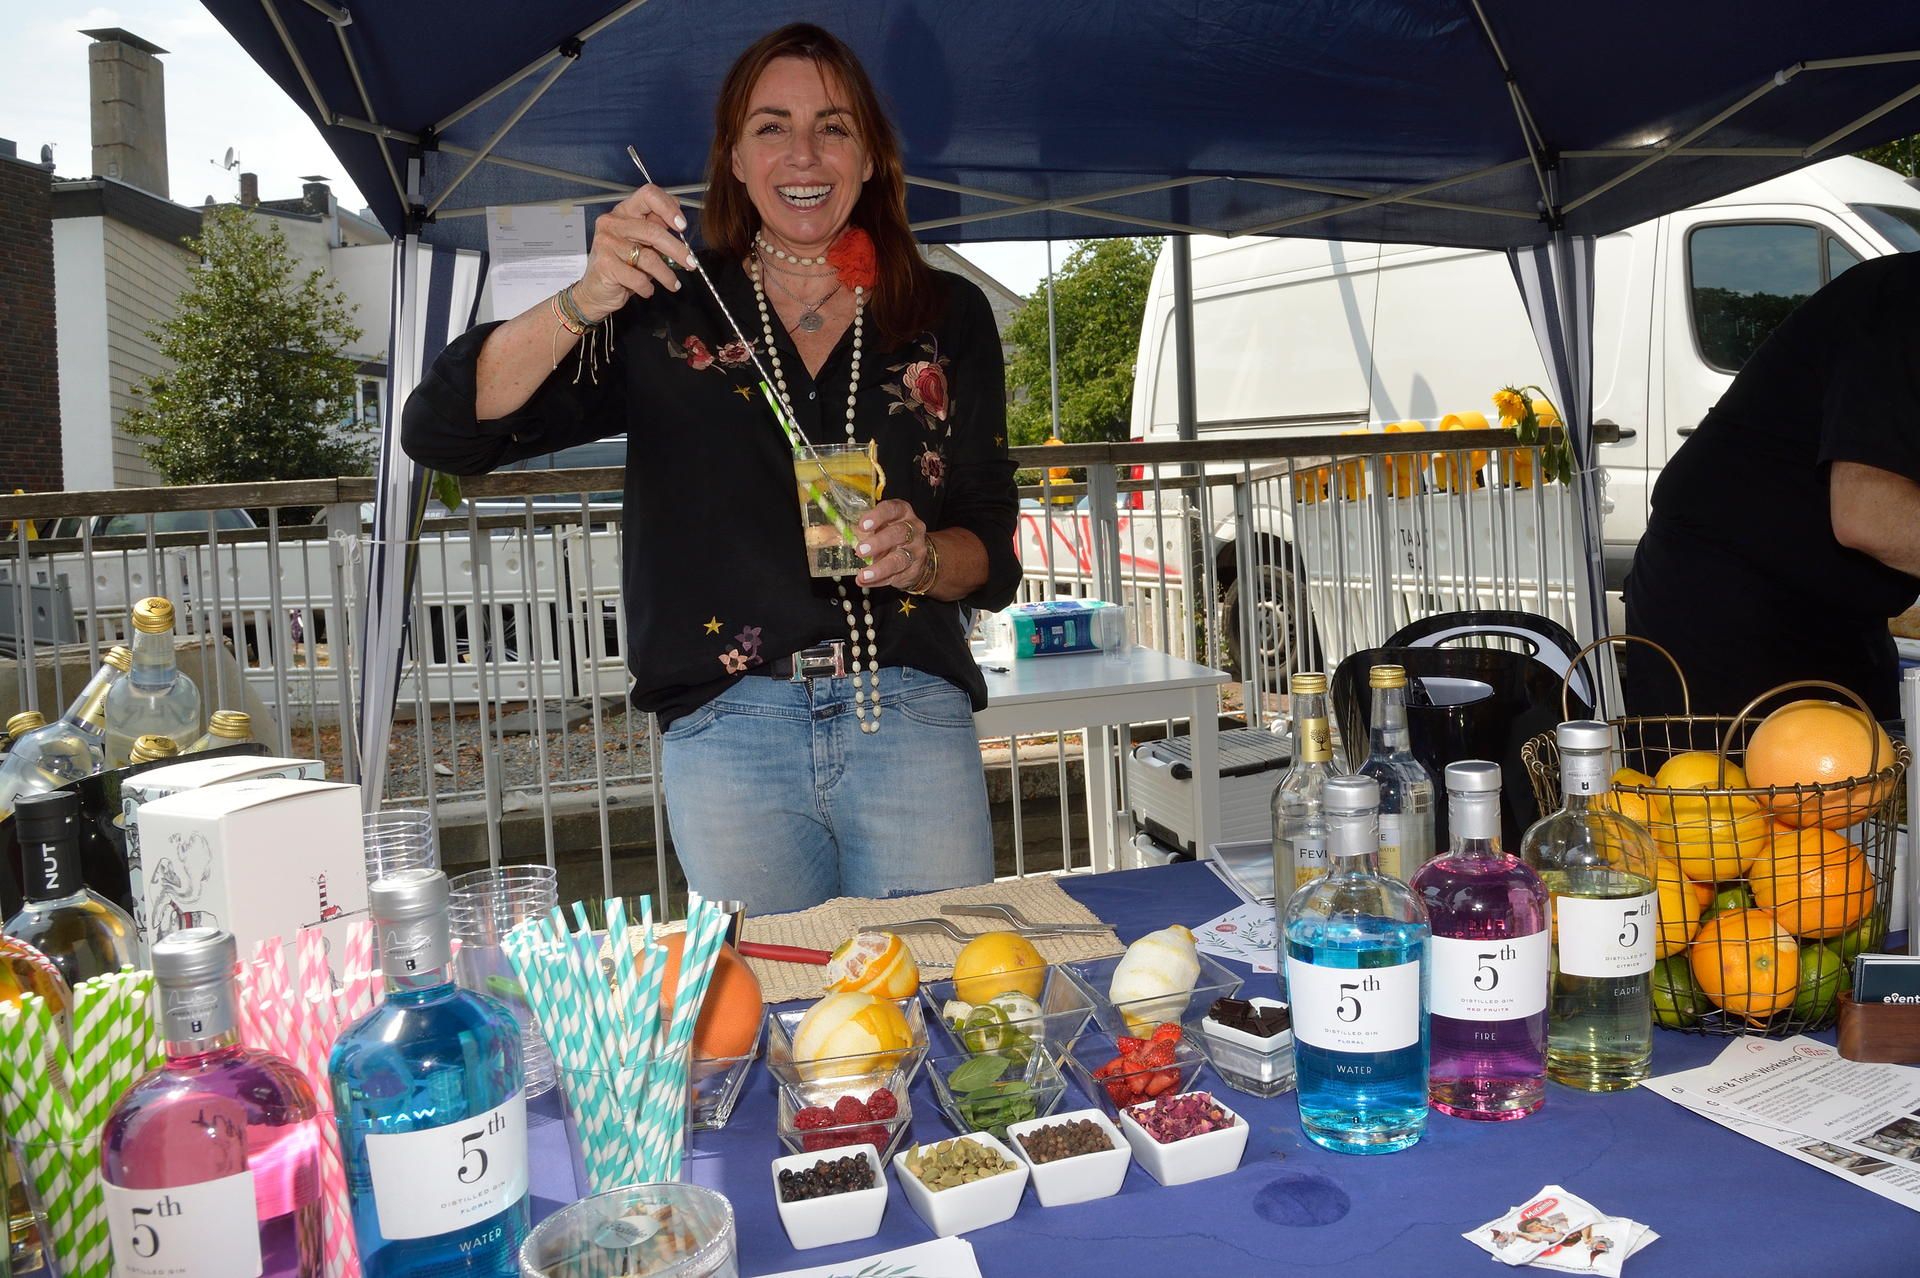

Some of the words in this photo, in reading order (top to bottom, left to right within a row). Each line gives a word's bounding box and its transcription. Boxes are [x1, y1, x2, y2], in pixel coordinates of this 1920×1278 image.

[42, 843, 60, 889] NUT
[1618, 899, 1651, 948] 5th
[1473, 944, 1516, 992] 5th
[1336, 974, 1381, 1023] 5th
[1614, 985, 1641, 997] EARTH
[1324, 1027, 1362, 1036] DISTILLED
[1474, 1031, 1496, 1041] FIRE
[1336, 1064, 1372, 1075] WATER
[1707, 1082, 1729, 1094] Gin
[1731, 1072, 1760, 1084] Tonic
[1754, 1055, 1802, 1075] Workshop
[457, 1111, 506, 1184] 5th
[440, 1188, 490, 1209] DISTILLED
[460, 1199, 494, 1214] FLORAL
[131, 1195, 183, 1258] 5th
[459, 1227, 502, 1252] WATER
